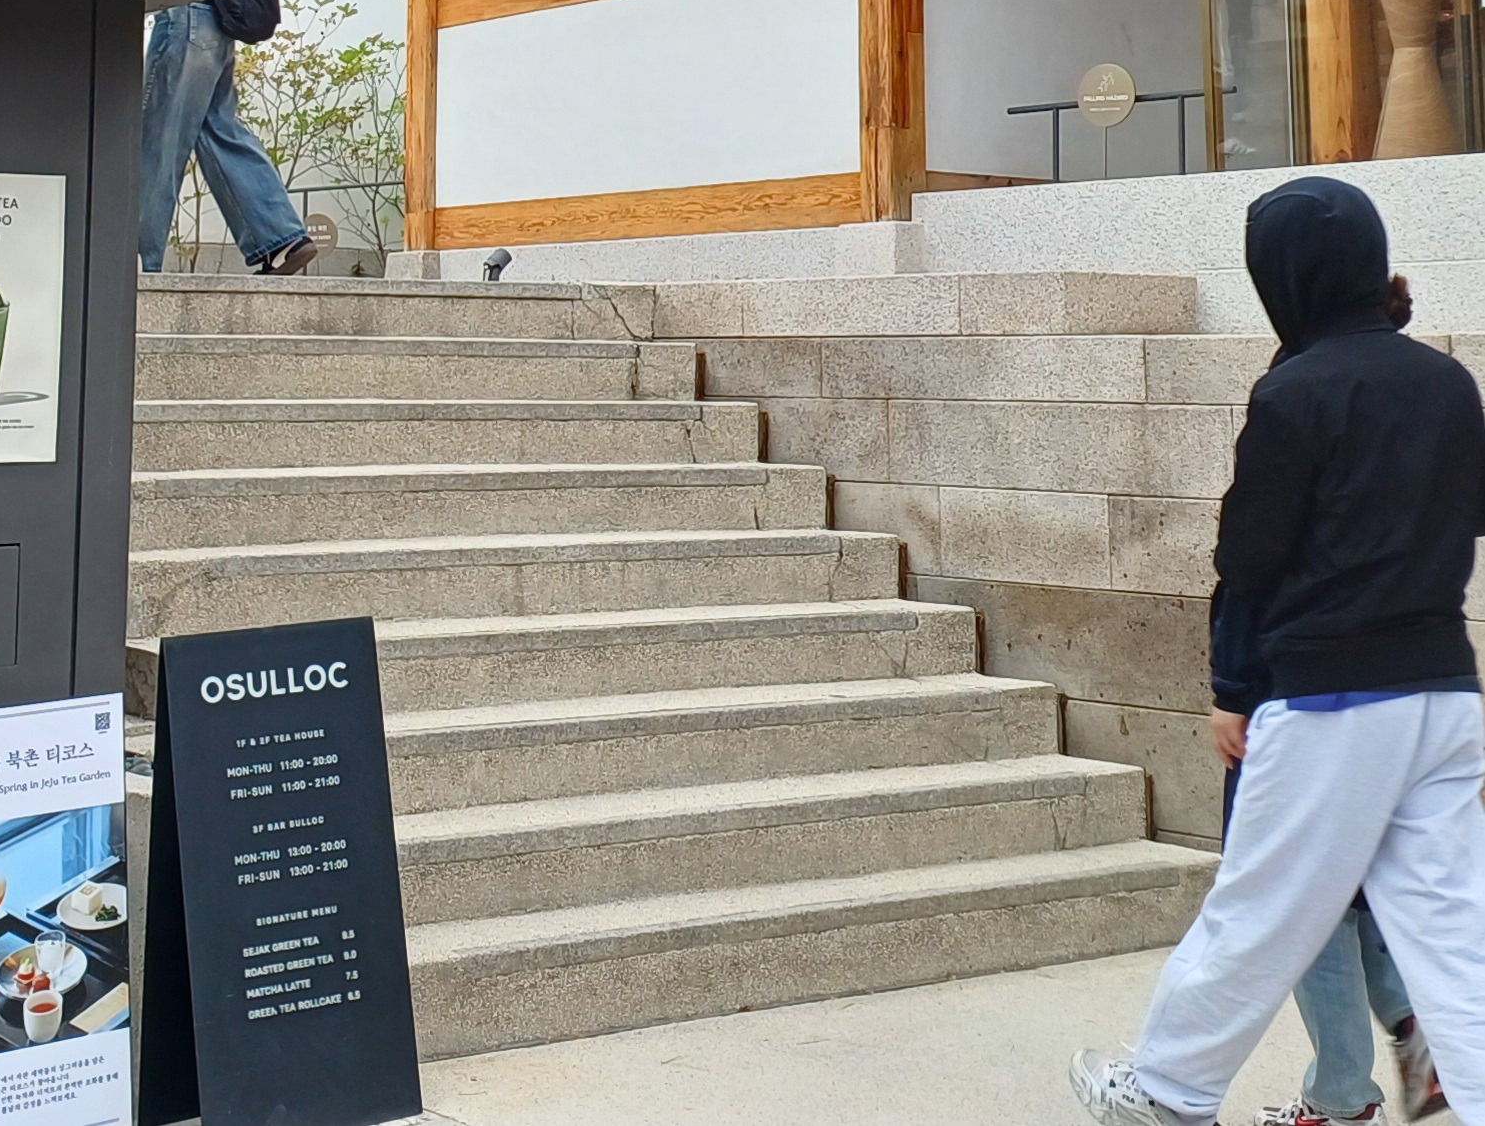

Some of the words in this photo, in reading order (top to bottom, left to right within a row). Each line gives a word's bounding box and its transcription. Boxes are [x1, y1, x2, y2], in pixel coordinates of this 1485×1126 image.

[200, 661, 349, 704] OSULLOC
[236, 739, 247, 749] 1F
[273, 733, 291, 744] TEA
[294, 729, 325, 741] HOUSE
[6, 748, 40, 771] 북촌
[46, 741, 95, 764] 티코스
[226, 763, 273, 778] MON-THU
[279, 758, 305, 771] 11:00
[312, 753, 339, 767] 20:00
[30, 780, 39, 789] in
[61, 775, 77, 784] Tea
[79, 770, 111, 782] Garden
[230, 785, 273, 800] FRI-SUN
[281, 779, 307, 792] 11:00
[314, 775, 341, 788] 21:00
[267, 821, 287, 832] BAR
[234, 849, 281, 866] MON-THU
[287, 844, 312, 857] 13:00
[238, 869, 281, 885] FRI-SUN
[289, 863, 314, 877] 13:00
[322, 858, 349, 872] 21:00
[256, 910, 309, 926] SIGNATURE
[311, 905, 338, 917] MENU
[243, 944, 271, 957] SEJAK
[272, 939, 301, 952] GREEN
[302, 936, 320, 947] TEA
[244, 963, 285, 978] ROASTED
[286, 957, 315, 970] GREEN
[316, 954, 334, 965] TEA
[246, 984, 284, 999] MATCHA
[284, 978, 311, 992] LATTE
[278, 1002, 296, 1014] TEA
[298, 993, 343, 1010] ROLLCAKE
